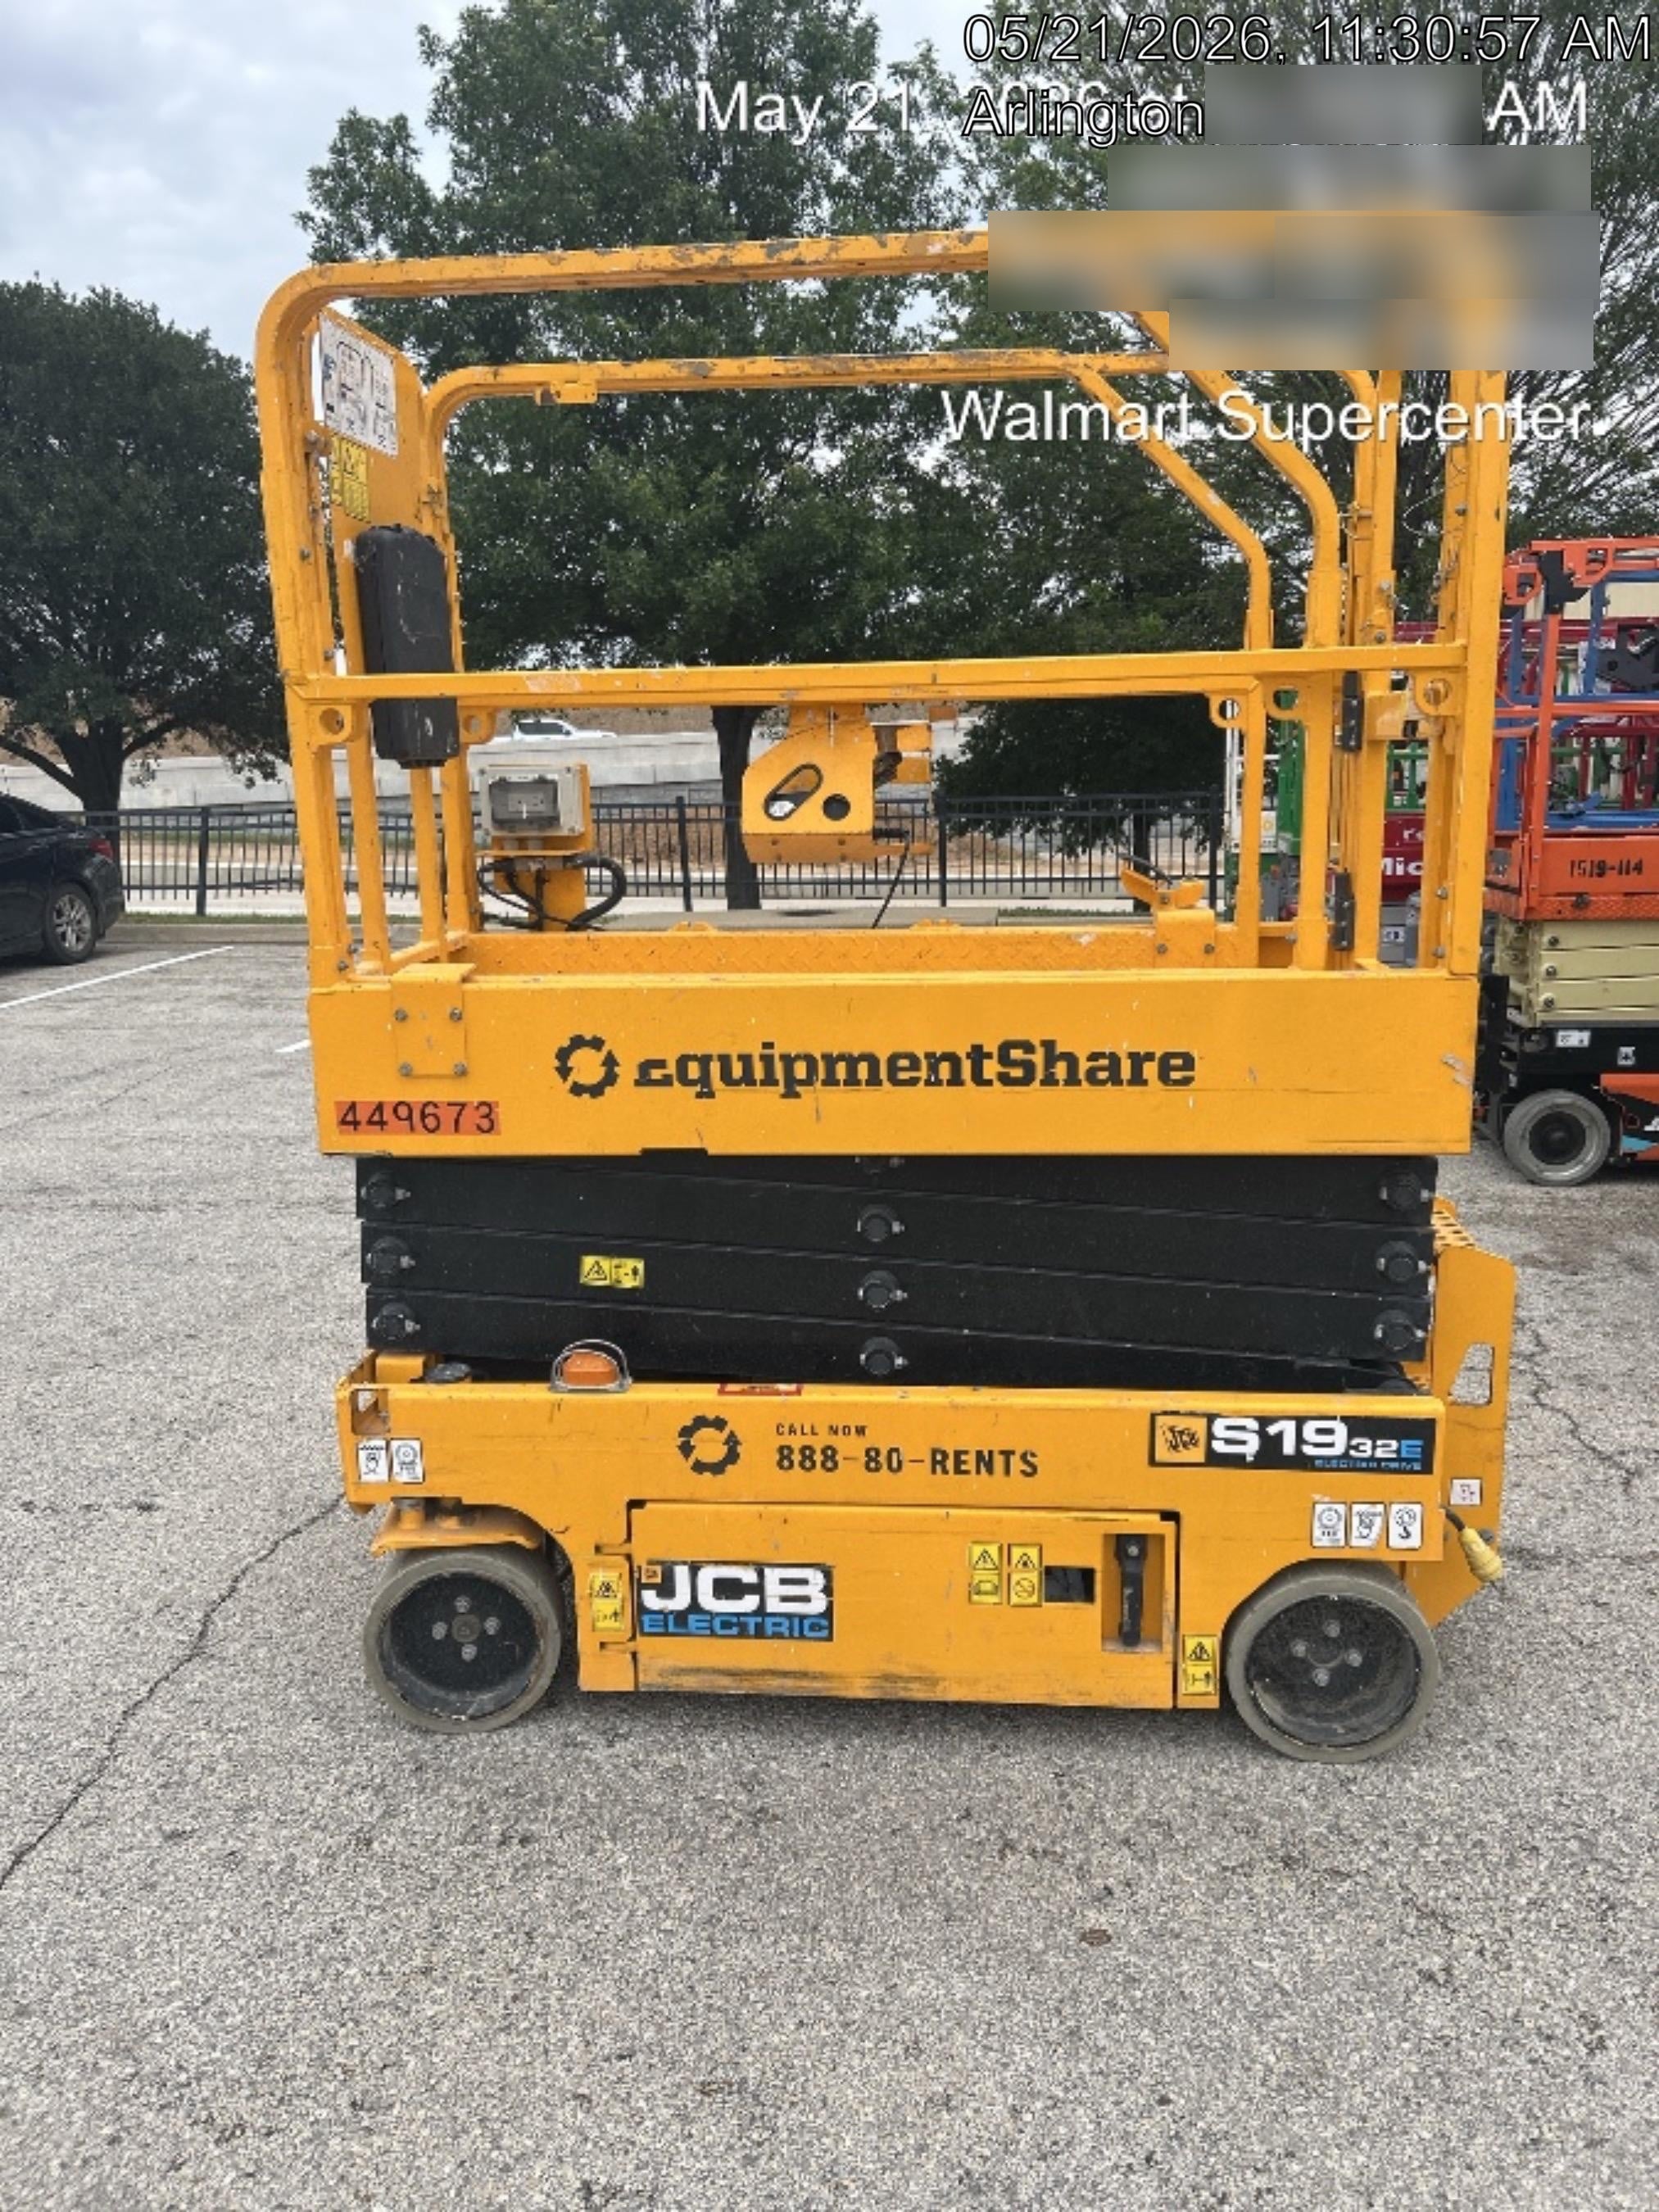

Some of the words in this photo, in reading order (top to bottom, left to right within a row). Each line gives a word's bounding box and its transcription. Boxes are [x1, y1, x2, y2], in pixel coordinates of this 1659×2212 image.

[338, 1100, 496, 1134] 449673
[776, 1422, 819, 1436] CALL
[828, 1425, 868, 1438] NOW
[776, 1444, 1039, 1477] 888-80-RENTS
[641, 1565, 828, 1615] JCB
[641, 1614, 829, 1638] ELECTRIC
